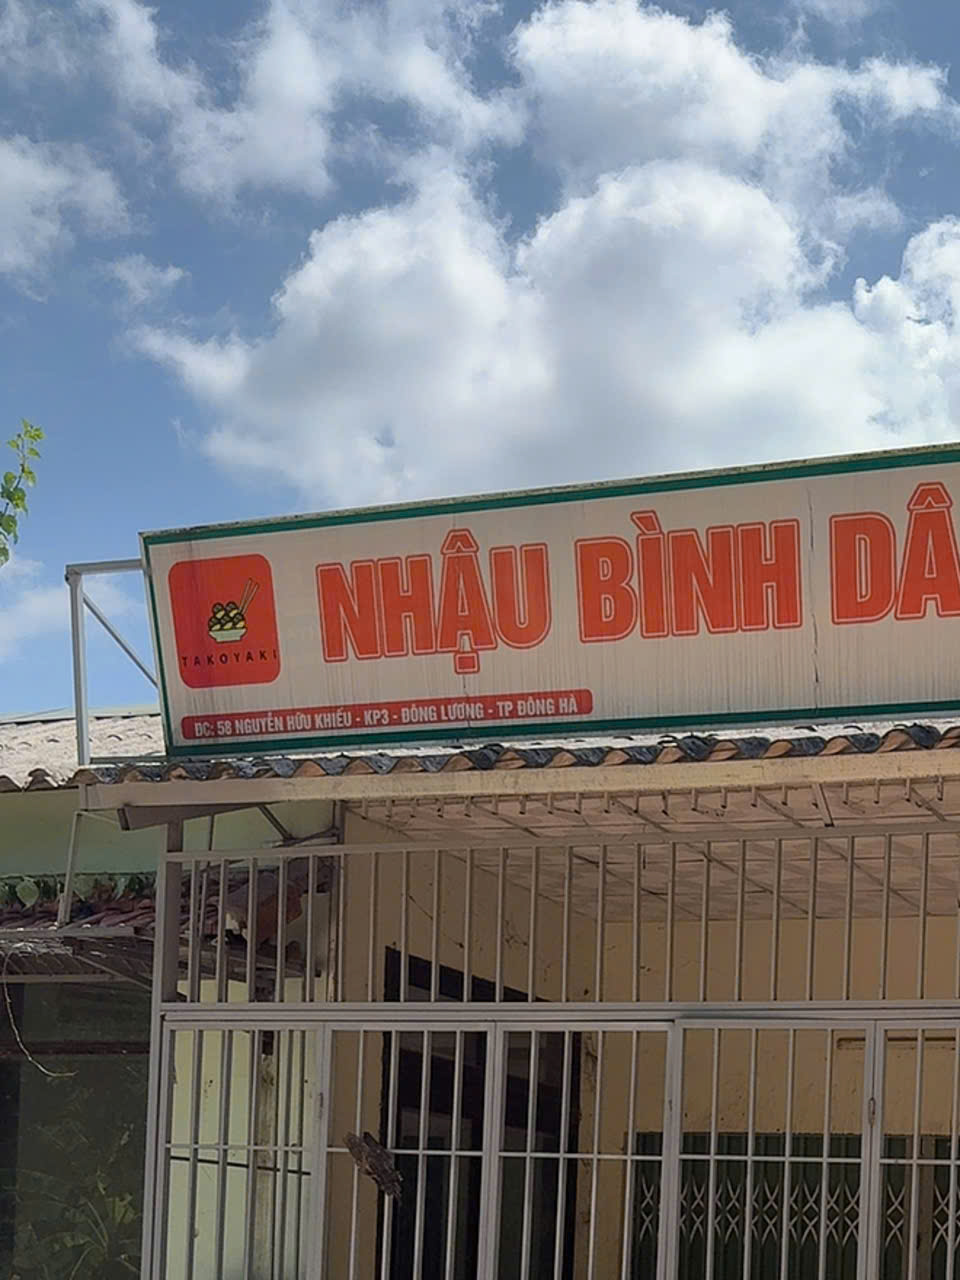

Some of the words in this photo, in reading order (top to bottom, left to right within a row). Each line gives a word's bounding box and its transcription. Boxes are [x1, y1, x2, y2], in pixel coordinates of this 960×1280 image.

[314, 528, 552, 674] NHẬU
[575, 510, 803, 644] BÌNH
[217, 720, 232, 736] 58
[364, 708, 389, 726] KP3
[401, 704, 437, 723] ĐÔNG
[441, 702, 484, 719] LƯƠNG
[497, 701, 513, 717] TP
[517, 695, 554, 715] ĐÔNG
[559, 694, 577, 713] HÀ
